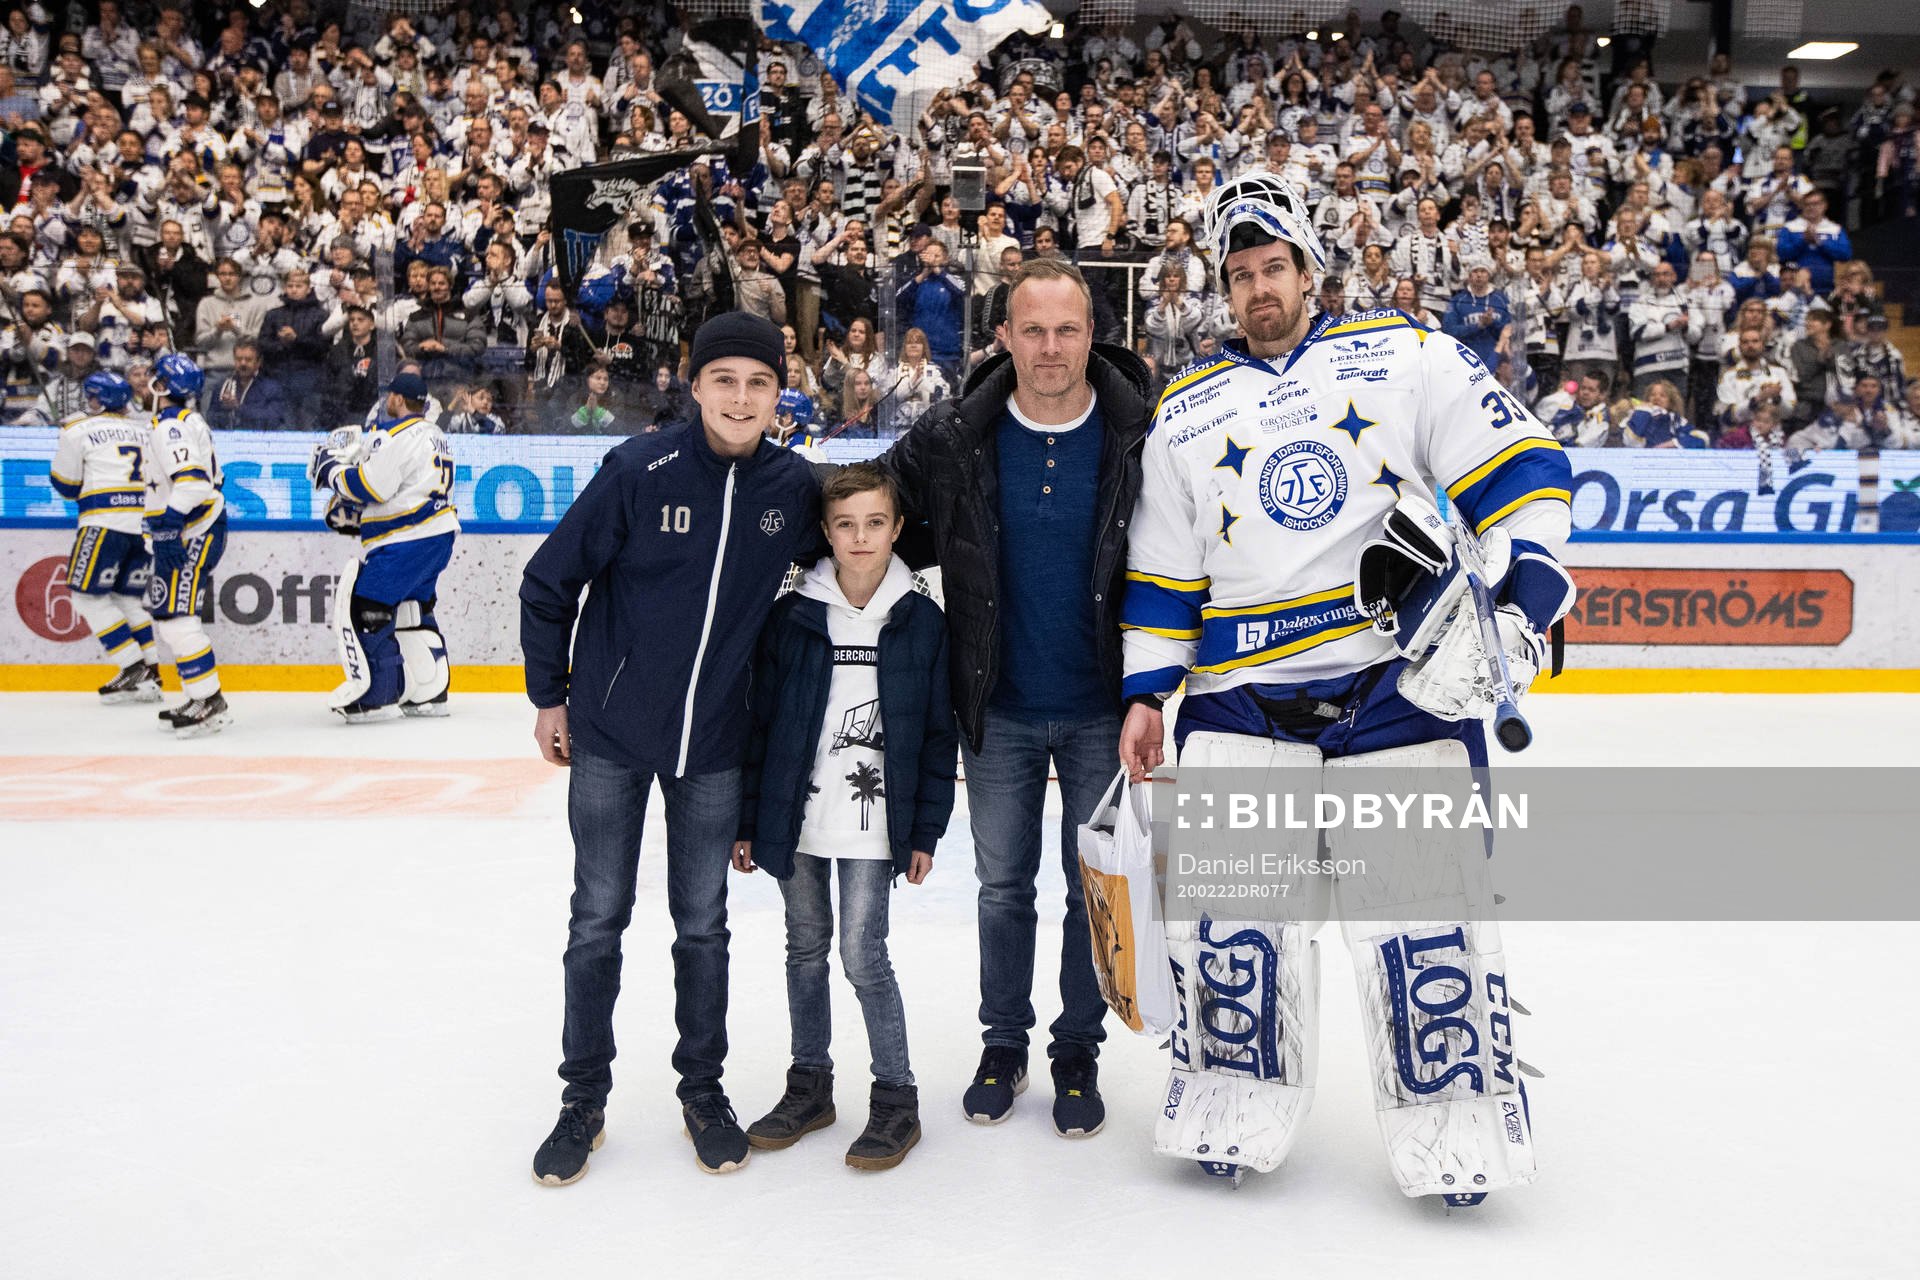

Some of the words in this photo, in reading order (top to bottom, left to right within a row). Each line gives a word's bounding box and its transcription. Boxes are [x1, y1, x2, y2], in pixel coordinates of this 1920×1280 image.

[1310, 316, 1335, 340] TEGERA
[1224, 350, 1249, 365] TEGERA
[1329, 349, 1395, 363] LEKSANDS
[1336, 368, 1389, 381] dalakraft
[1188, 378, 1231, 402] Bergkvist
[1270, 387, 1311, 407] TEGERA
[1481, 390, 1528, 429] 33
[173, 448, 189, 464] 17
[648, 450, 679, 471] CCM
[1260, 457, 1279, 515] LEKSANDS
[1570, 470, 1750, 532] Orsa
[660, 505, 691, 533] 10
[1282, 507, 1337, 530] ISHOCKEY
[342, 627, 362, 681] CCM
[1485, 972, 1514, 1085] CCM
